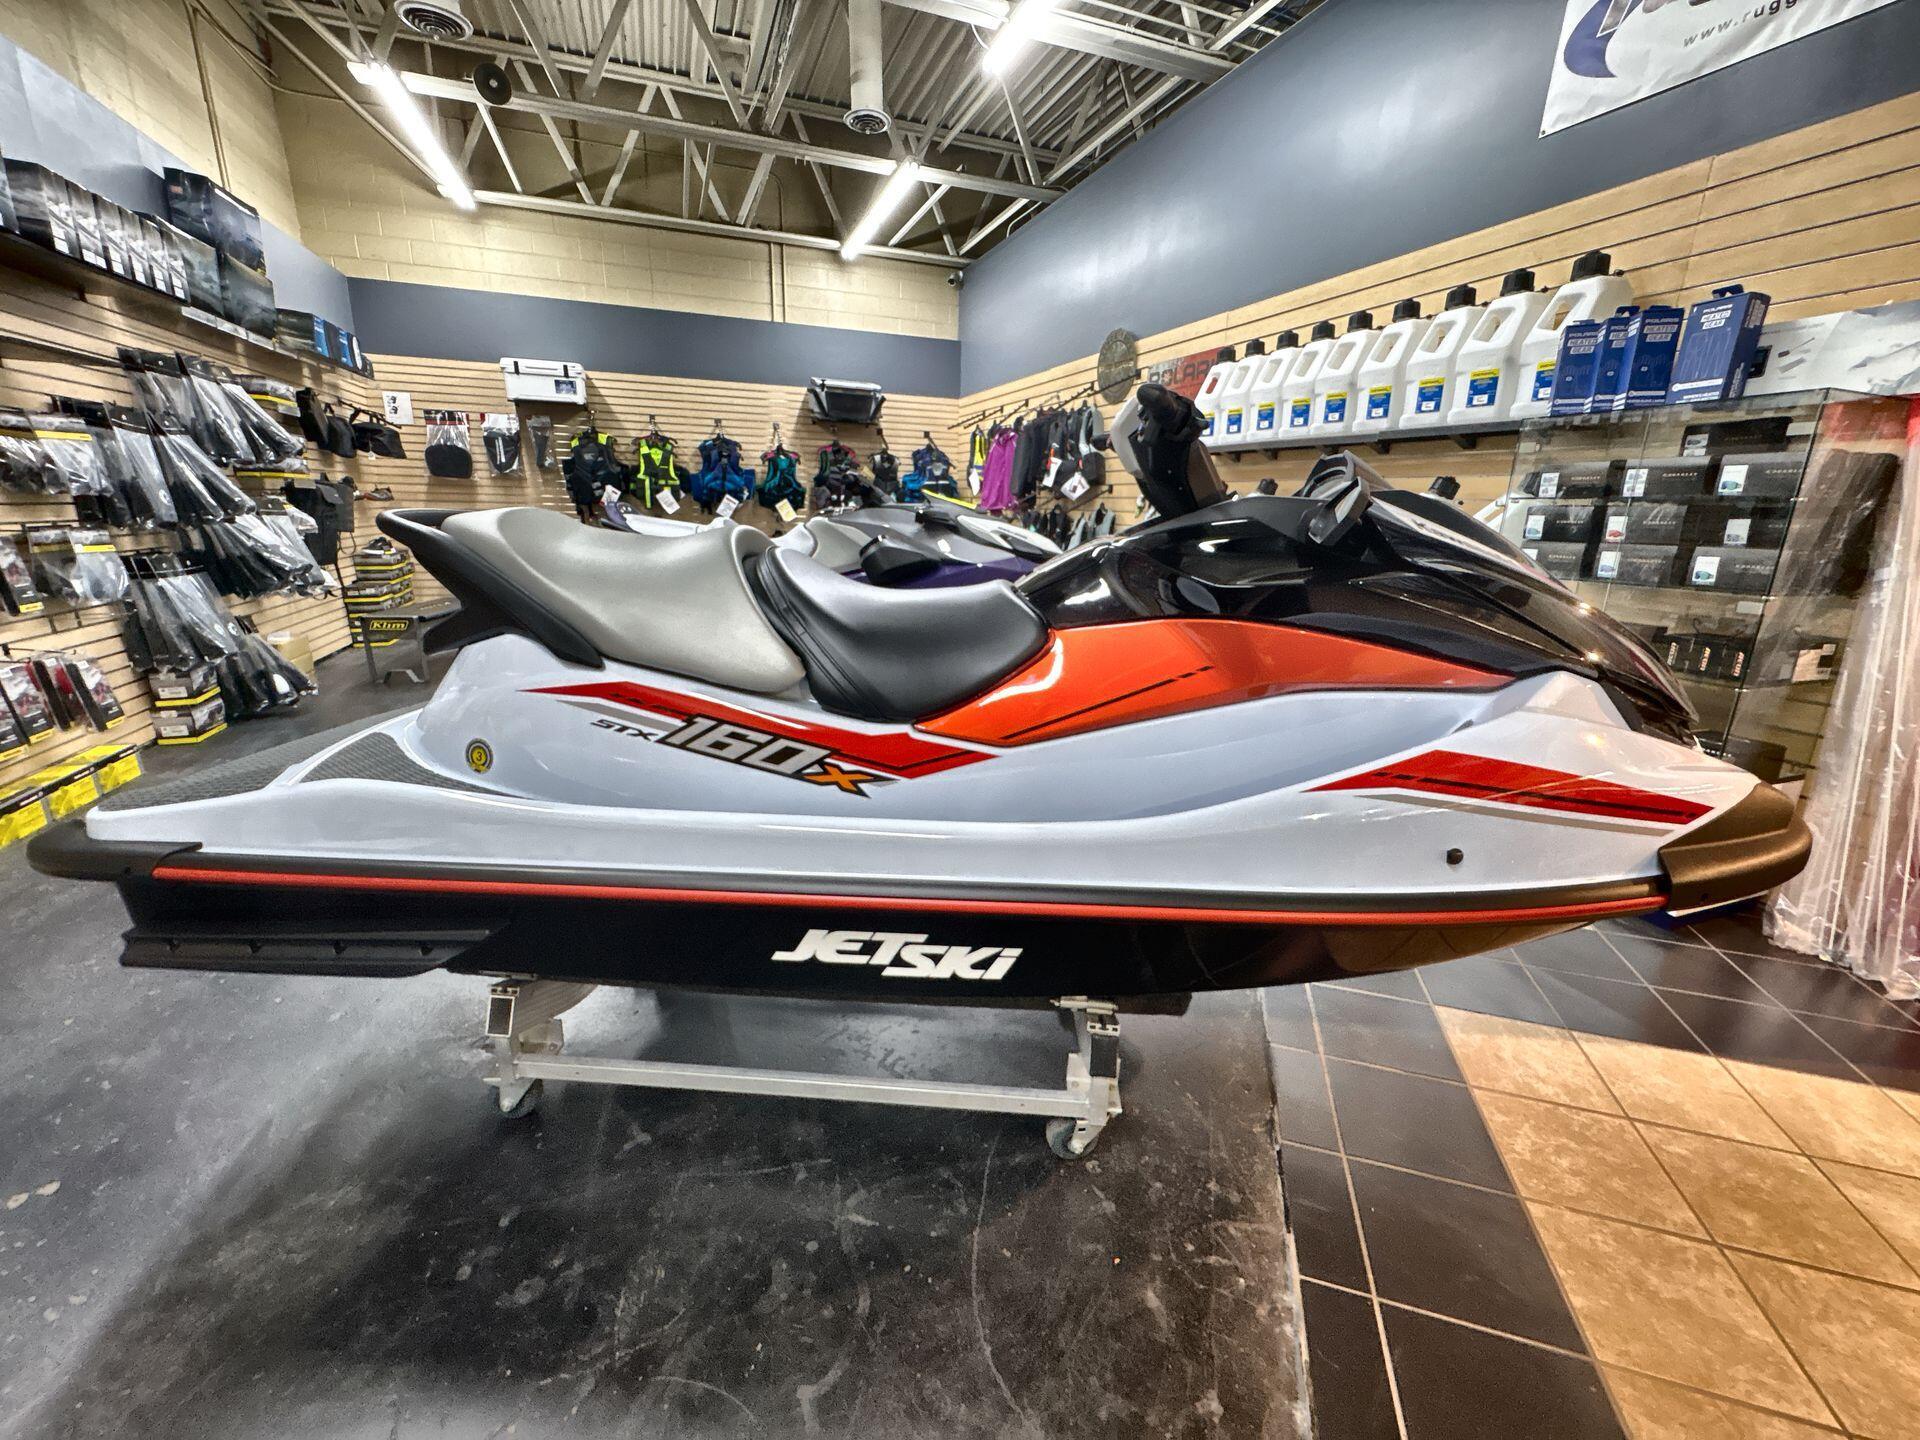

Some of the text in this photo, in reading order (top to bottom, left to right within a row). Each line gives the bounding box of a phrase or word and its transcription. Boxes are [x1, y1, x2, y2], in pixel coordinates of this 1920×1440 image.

[1702, 311, 1731, 321] HEATED
[1645, 325, 1677, 333] HEATED
[1703, 319, 1724, 329] GEAR
[1647, 333, 1671, 341] GEAR
[1571, 346, 1593, 354] GEAR
[590, 718, 659, 742] STX
[475, 751, 483, 762] 3
